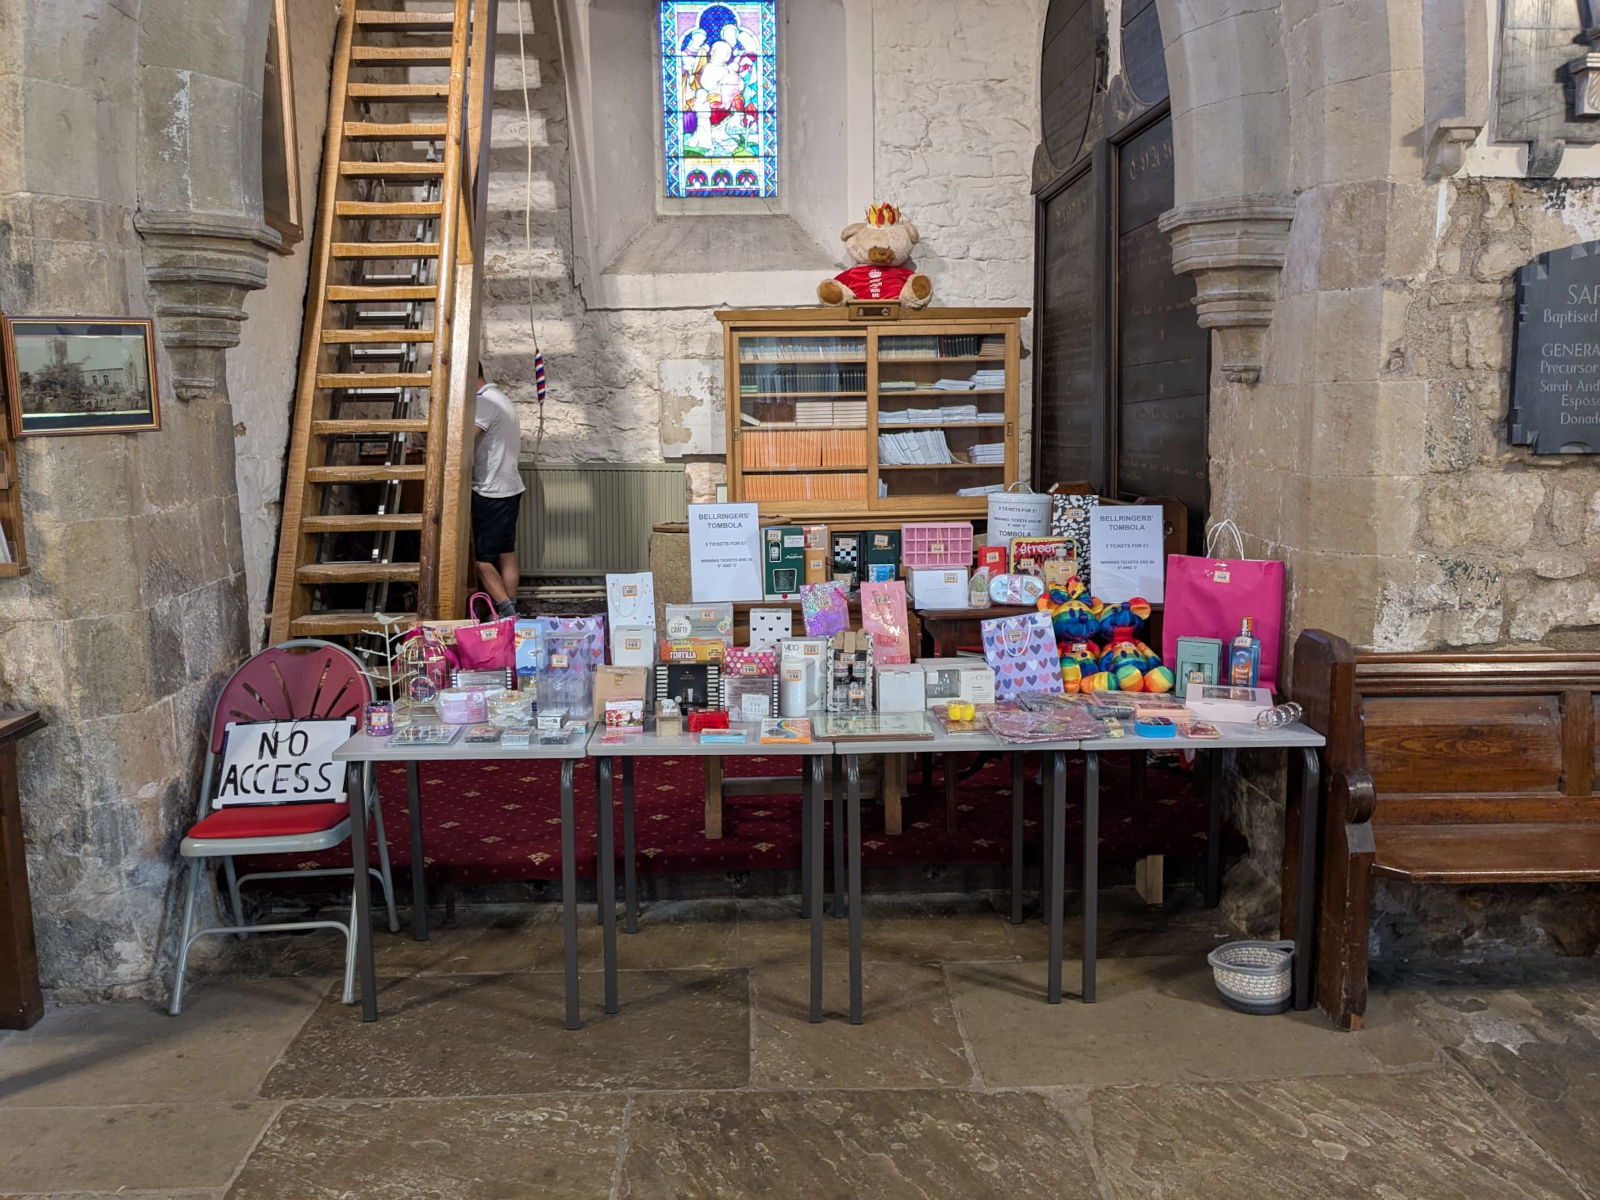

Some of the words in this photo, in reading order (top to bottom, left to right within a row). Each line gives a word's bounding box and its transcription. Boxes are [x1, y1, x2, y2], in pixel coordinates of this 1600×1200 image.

[1543, 308, 1598, 329] Baptised
[1541, 343, 1600, 358] GENERA
[1539, 359, 1599, 374] Precursor
[1539, 379, 1572, 392] Sarah
[1560, 412, 1600, 425] Donad
[998, 530, 1032, 538] TOMBOLA
[669, 651, 697, 659] TORTILLA
[258, 730, 309, 760] NO
[220, 762, 333, 797] ACCESS
